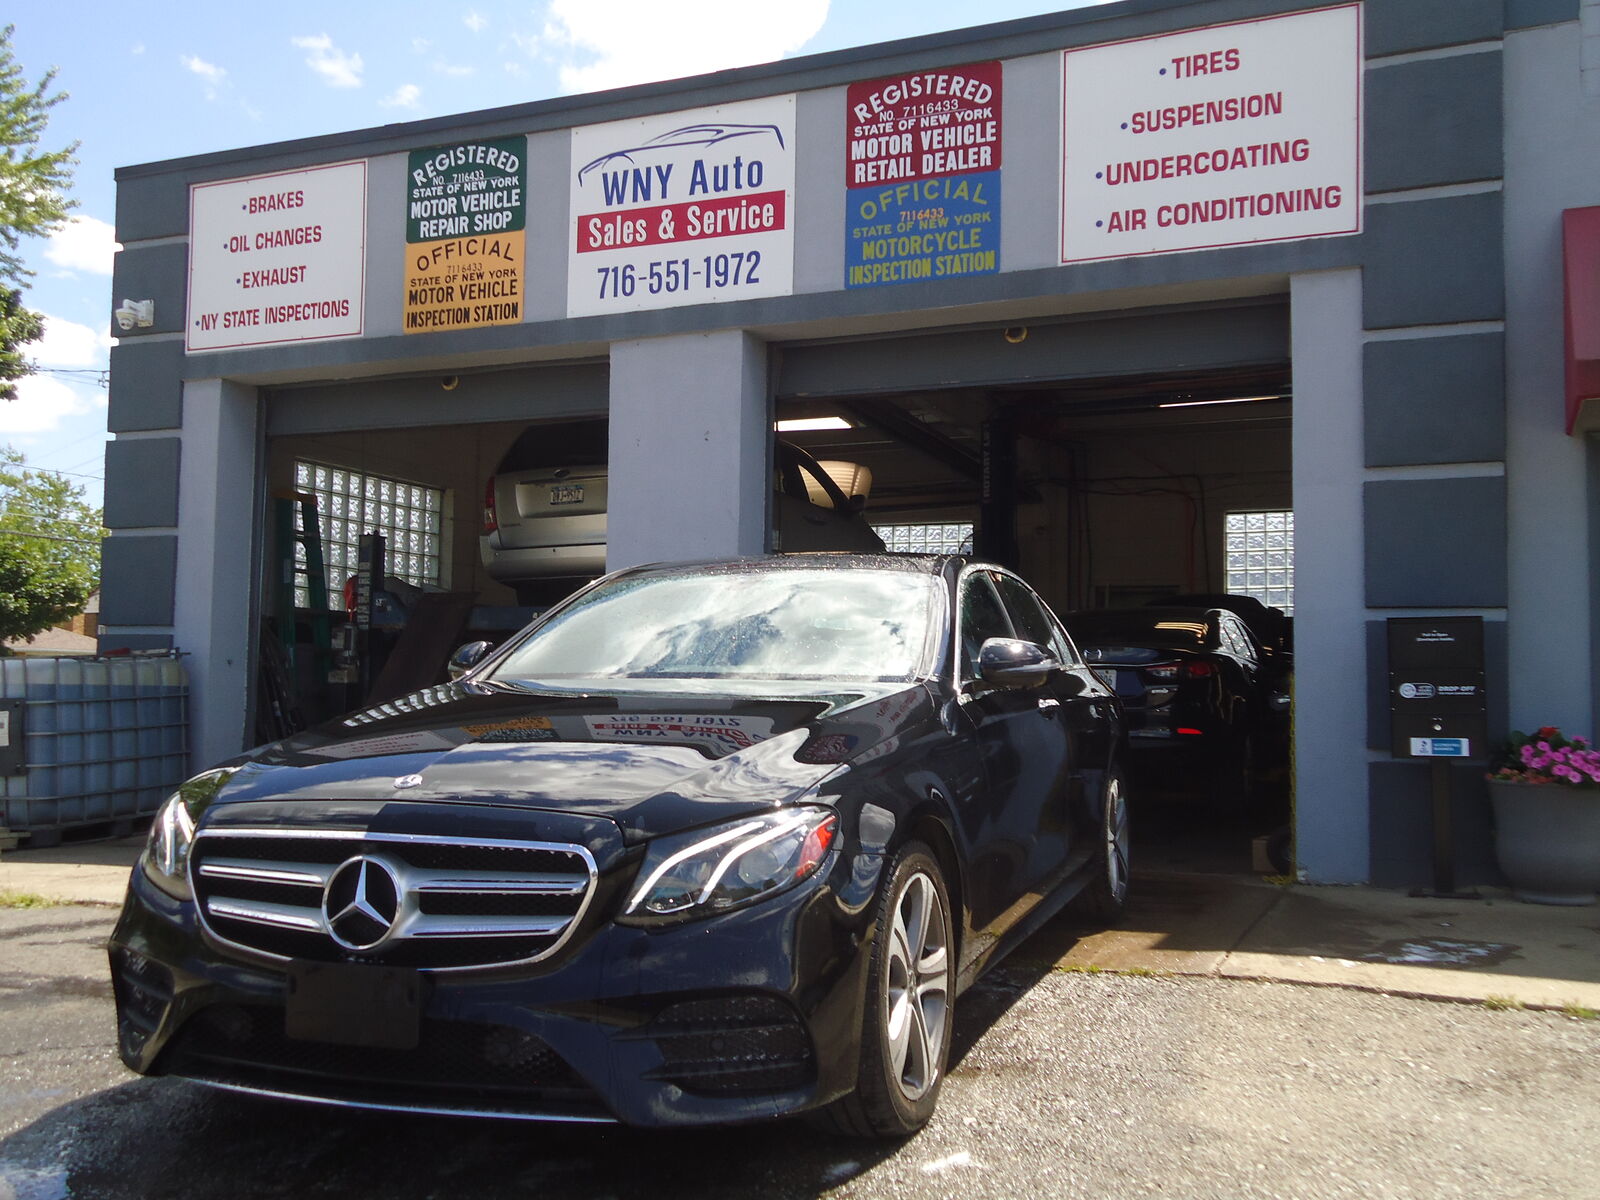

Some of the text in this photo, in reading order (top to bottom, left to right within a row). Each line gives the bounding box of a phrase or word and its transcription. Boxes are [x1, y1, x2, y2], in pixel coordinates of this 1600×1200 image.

[1172, 49, 1240, 79] TIRES
[854, 74, 992, 123] REGISTERED
[904, 99, 958, 117] 7116433
[1131, 91, 1282, 134] SUSPENSION
[855, 107, 992, 137] STATE OF NEW YORK
[852, 121, 996, 160] MOTOR VEHICLE
[413, 146, 519, 186] REGISTERED
[453, 170, 484, 183] 7116433
[855, 146, 991, 183] RETAIL DEALER
[1106, 138, 1310, 186] UNDERCOATING
[413, 176, 519, 198] STATE OF NEW YORK
[602, 156, 763, 206] WNY Auto
[249, 191, 304, 213] BRAKES
[411, 188, 520, 219] MOTOR VEHICLE
[860, 180, 987, 219] OFFICIAL
[900, 208, 944, 222] 7116433
[1107, 185, 1341, 234] AIR CONDITIONING
[230, 226, 322, 252] OIL CHANGES
[420, 211, 512, 238] REPAIR SHOP
[589, 200, 774, 248] Sales & Service
[853, 212, 991, 238] STATE OF NEW YORK
[417, 239, 514, 271] OFFICIAL
[863, 228, 981, 260] MOTORCYCLE
[242, 266, 306, 288] EXHAUST
[411, 268, 516, 287] STATE OF NEW YORK
[448, 263, 482, 273] 7116433
[598, 250, 761, 299] 716-551-1972
[850, 250, 995, 285] INSPECTION STATION
[409, 279, 518, 306] MOTOR VEHICLE
[201, 299, 349, 331] NY STATE INSPECTIONS
[407, 302, 518, 328] INSPECTION STATION
